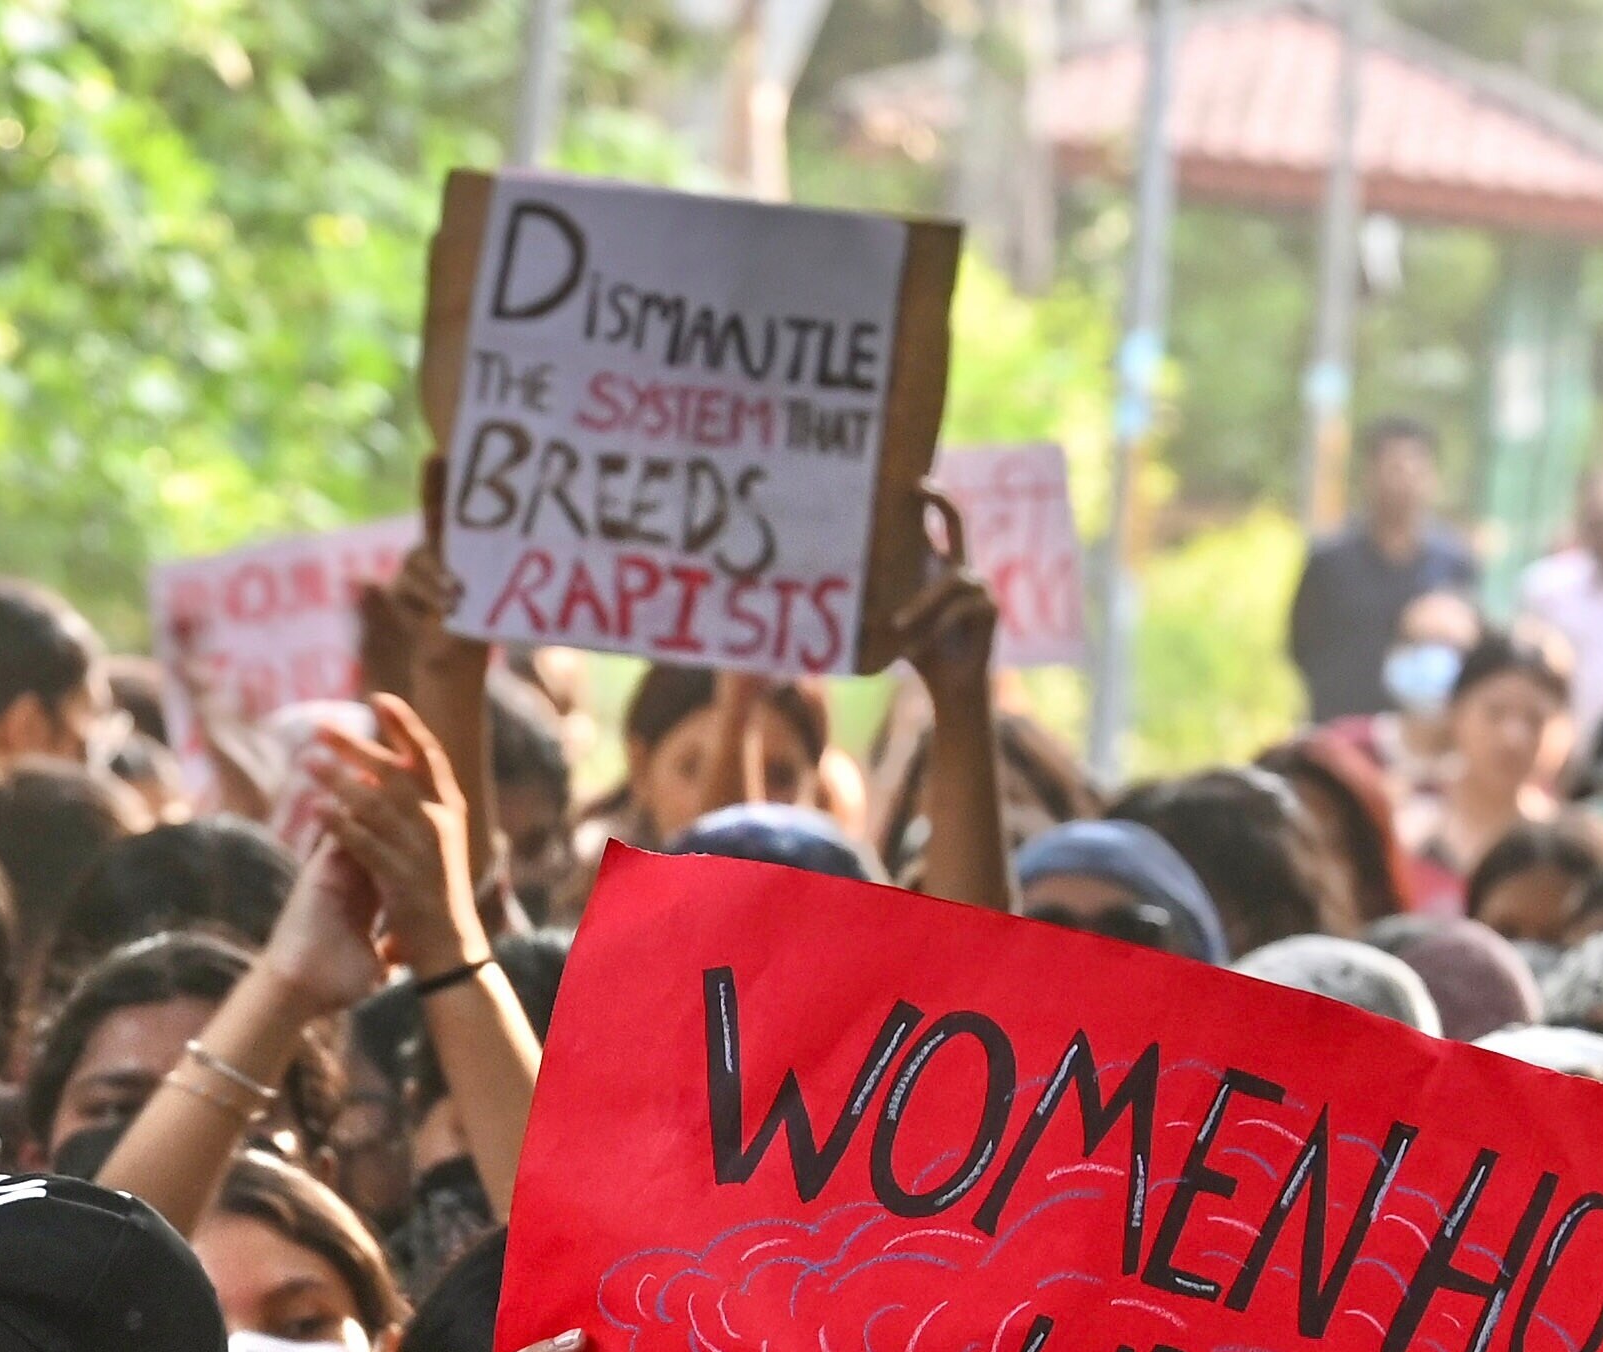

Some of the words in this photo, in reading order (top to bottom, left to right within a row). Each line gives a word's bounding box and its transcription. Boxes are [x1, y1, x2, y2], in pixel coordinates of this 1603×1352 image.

[473, 350, 553, 411] THE
[575, 370, 775, 449] SYSTEM
[786, 397, 872, 462] THAT
[457, 419, 775, 578] BREEDS
[485, 550, 849, 672] RAPISTS
[702, 965, 1419, 1340] WOMEN
